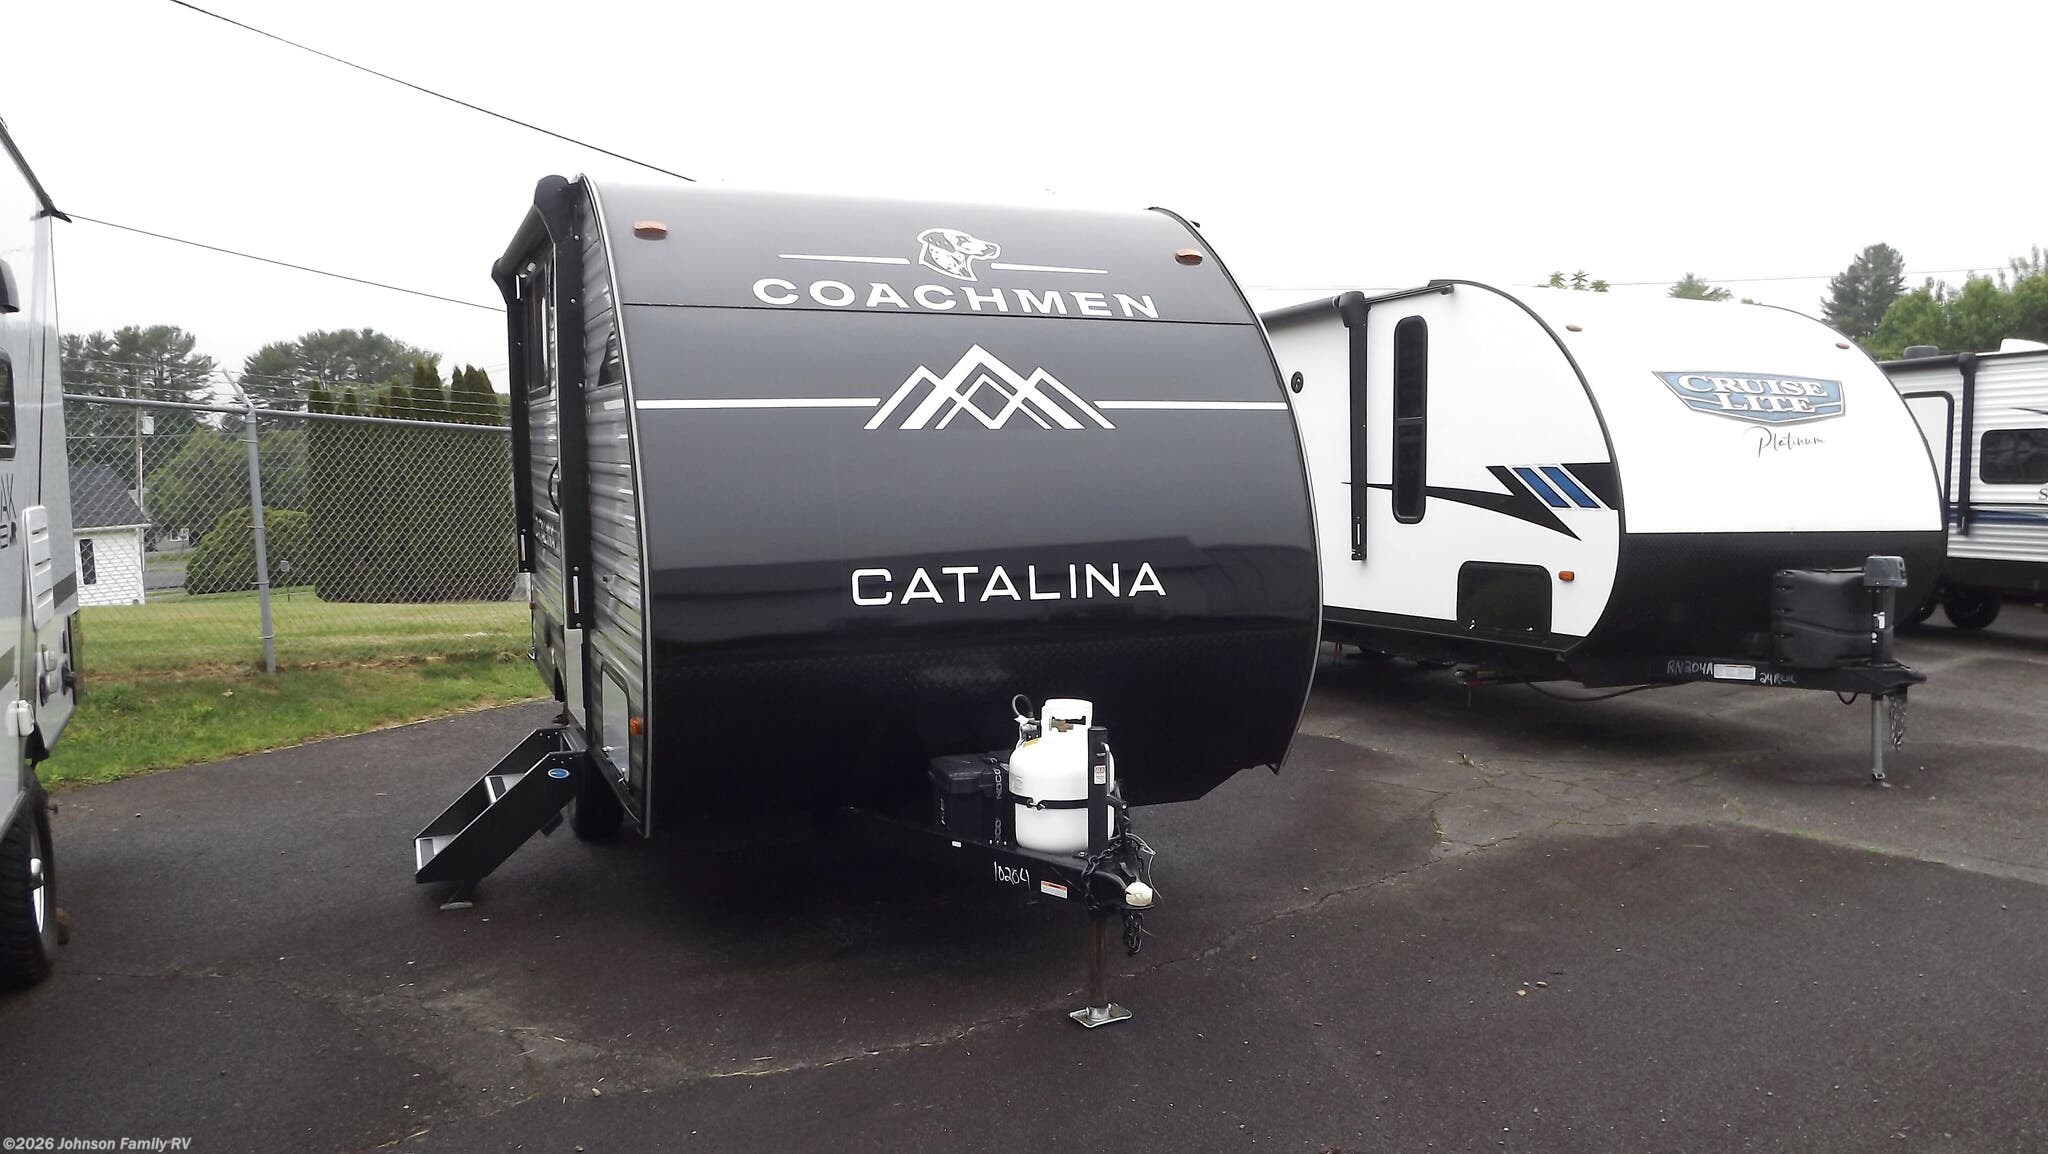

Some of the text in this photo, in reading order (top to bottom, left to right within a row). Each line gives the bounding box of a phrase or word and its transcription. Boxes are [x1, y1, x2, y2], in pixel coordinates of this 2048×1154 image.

[752, 277, 1160, 319] COACHMEN
[1678, 375, 1828, 397] CRUISE
[1713, 393, 1816, 413] LITE
[1745, 426, 1825, 458] Platinum
[851, 562, 1167, 607] CATALINA
[993, 861, 1031, 890] 10204
